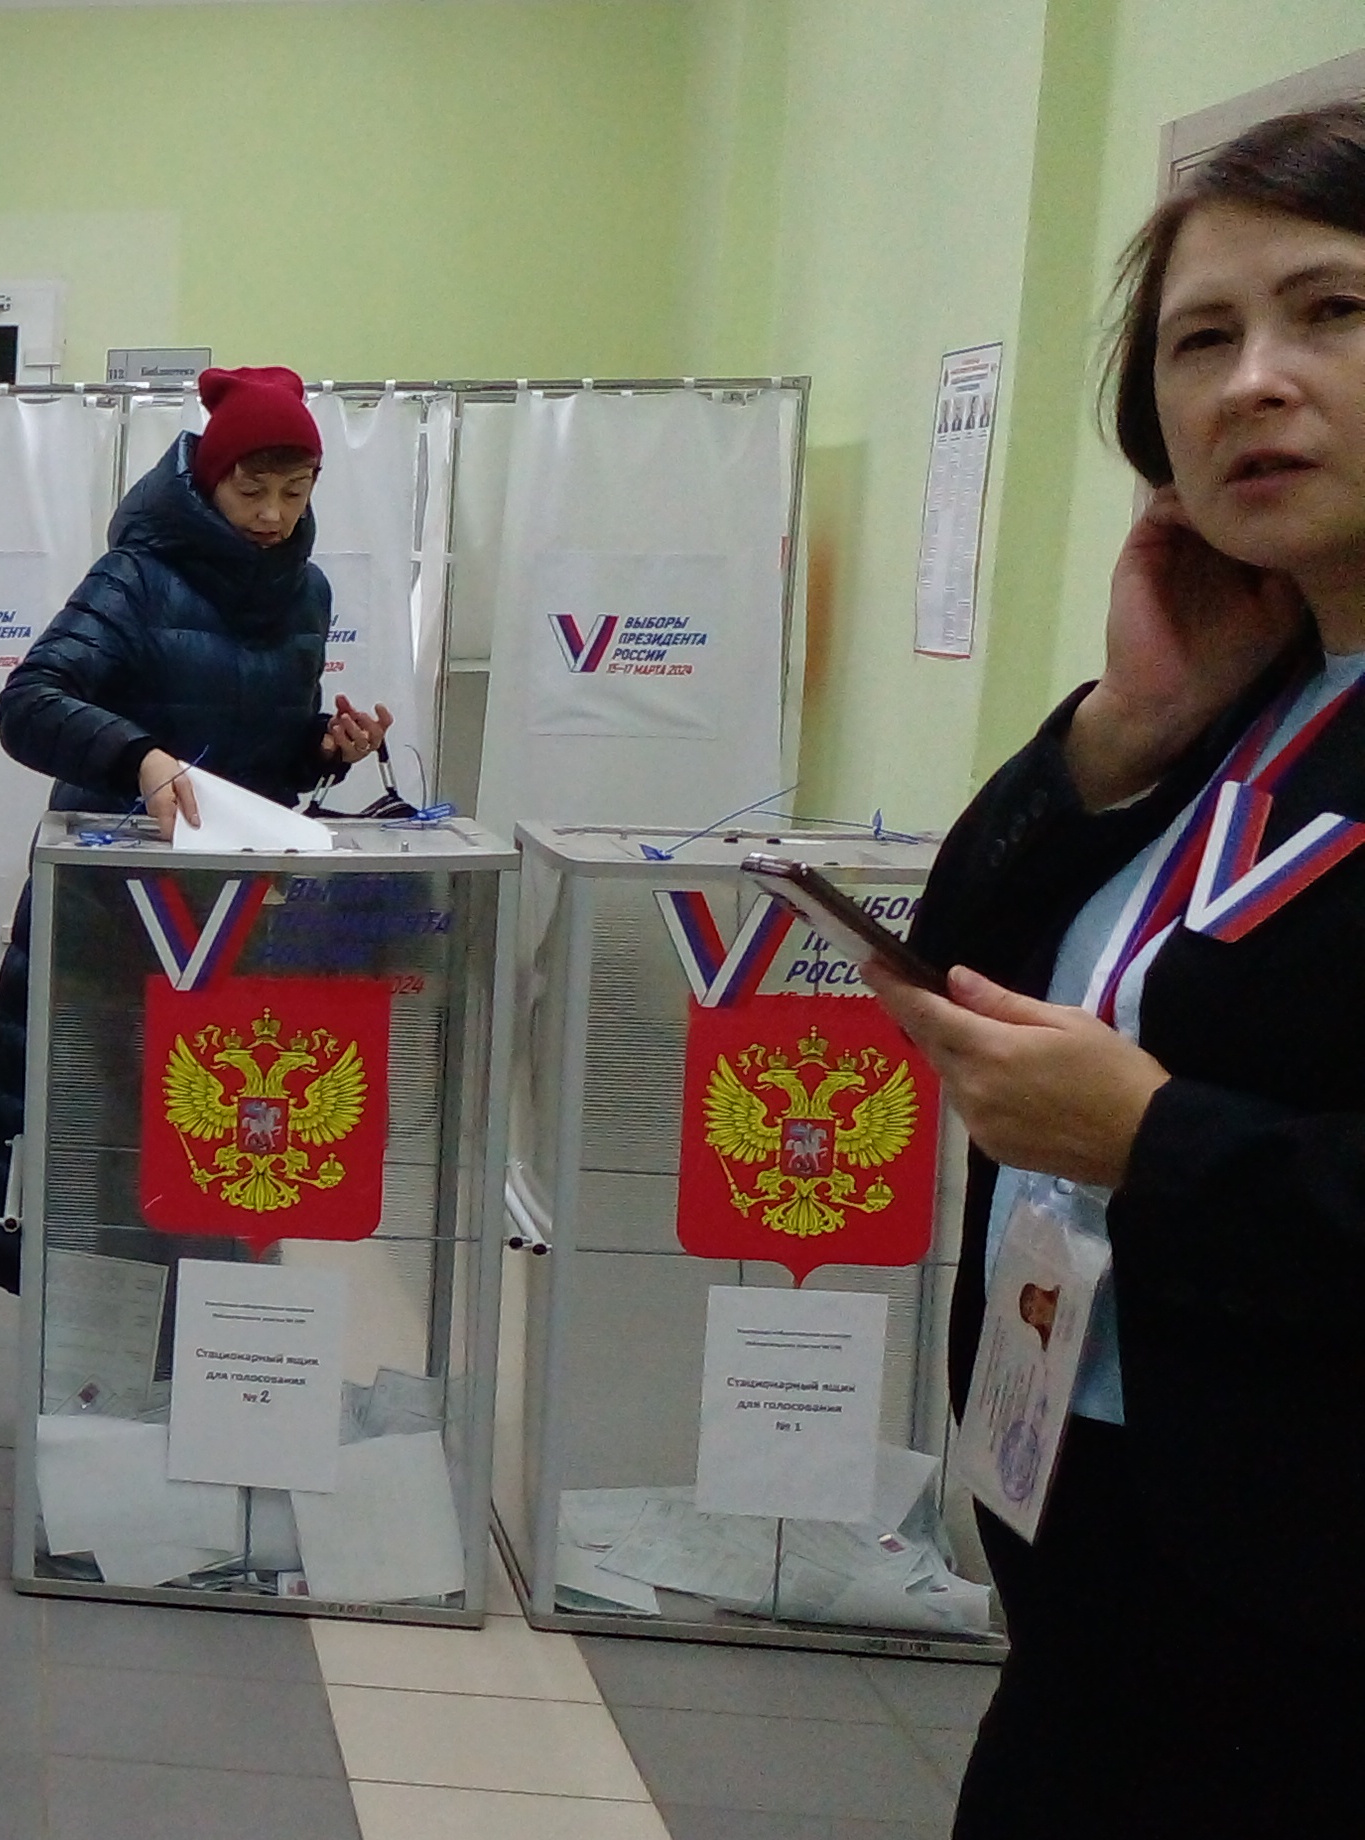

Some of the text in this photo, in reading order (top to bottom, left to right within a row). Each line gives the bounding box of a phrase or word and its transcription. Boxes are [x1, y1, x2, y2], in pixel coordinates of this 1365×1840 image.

[624, 616, 690, 629] ВЫБОРЫ
[618, 632, 708, 646] ПРЕЗИДЕНТА
[612, 648, 668, 662] РОССИИ
[633, 664, 665, 675] МАРТА
[666, 664, 693, 675] 2024
[784, 959, 863, 986] РОСС
[195, 1348, 319, 1366] Стационарный ящик
[206, 1371, 306, 1385] для голосования
[727, 1377, 856, 1393] Стационарный ящик
[242, 1390, 271, 1403] № 2
[736, 1400, 842, 1412] для голосования
[775, 1421, 802, 1431] № 1
